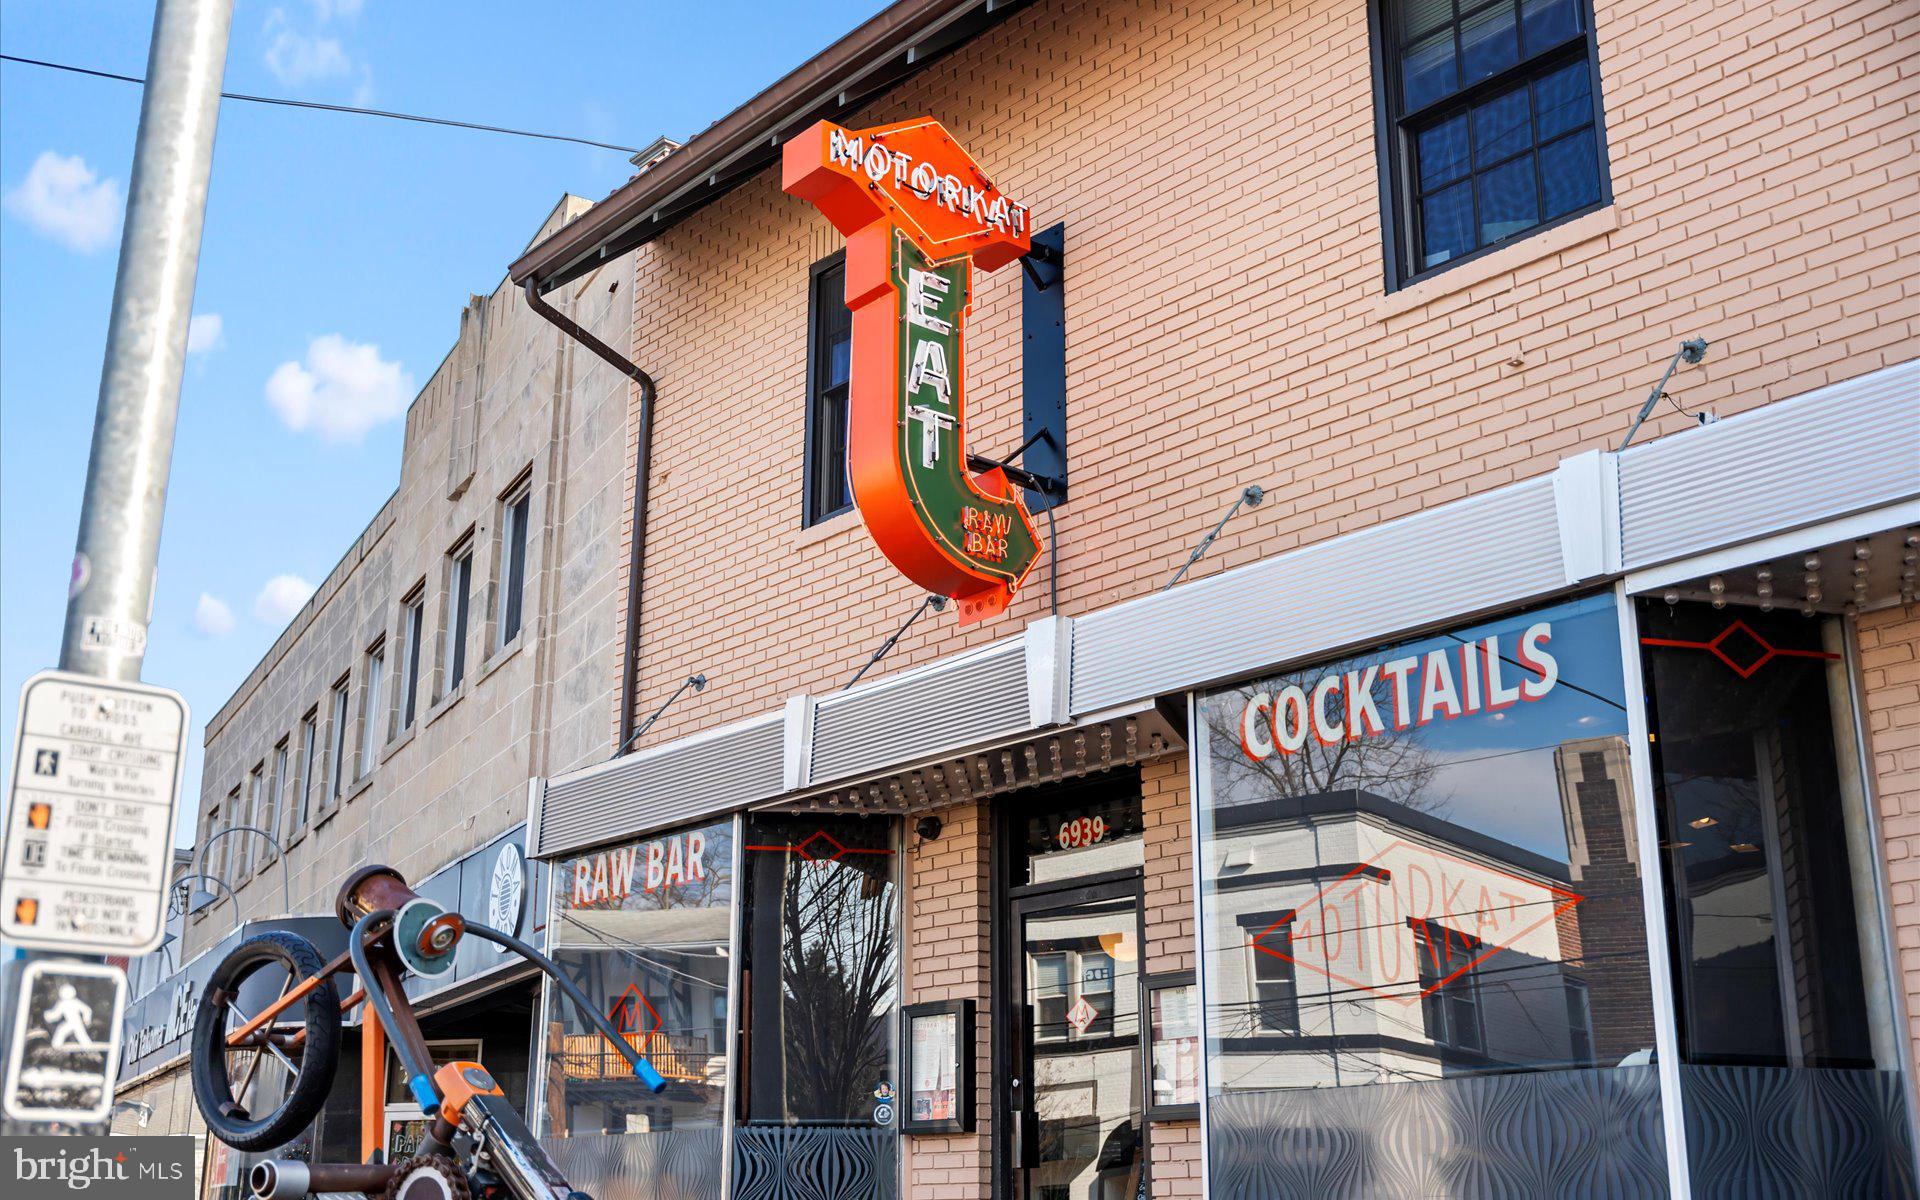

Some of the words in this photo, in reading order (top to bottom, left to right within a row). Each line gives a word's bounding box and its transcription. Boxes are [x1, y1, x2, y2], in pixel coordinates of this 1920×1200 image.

[829, 128, 1027, 238] MOTORKAT
[908, 267, 956, 470] EAT
[962, 505, 1012, 537] RAW
[964, 532, 1008, 563] BAR
[1241, 622, 1558, 762] COCKTAILS
[572, 846, 638, 909] RAW
[644, 831, 706, 895] BAR
[1059, 815, 1104, 850] 6939
[1288, 863, 1526, 984] MOTORKAT
